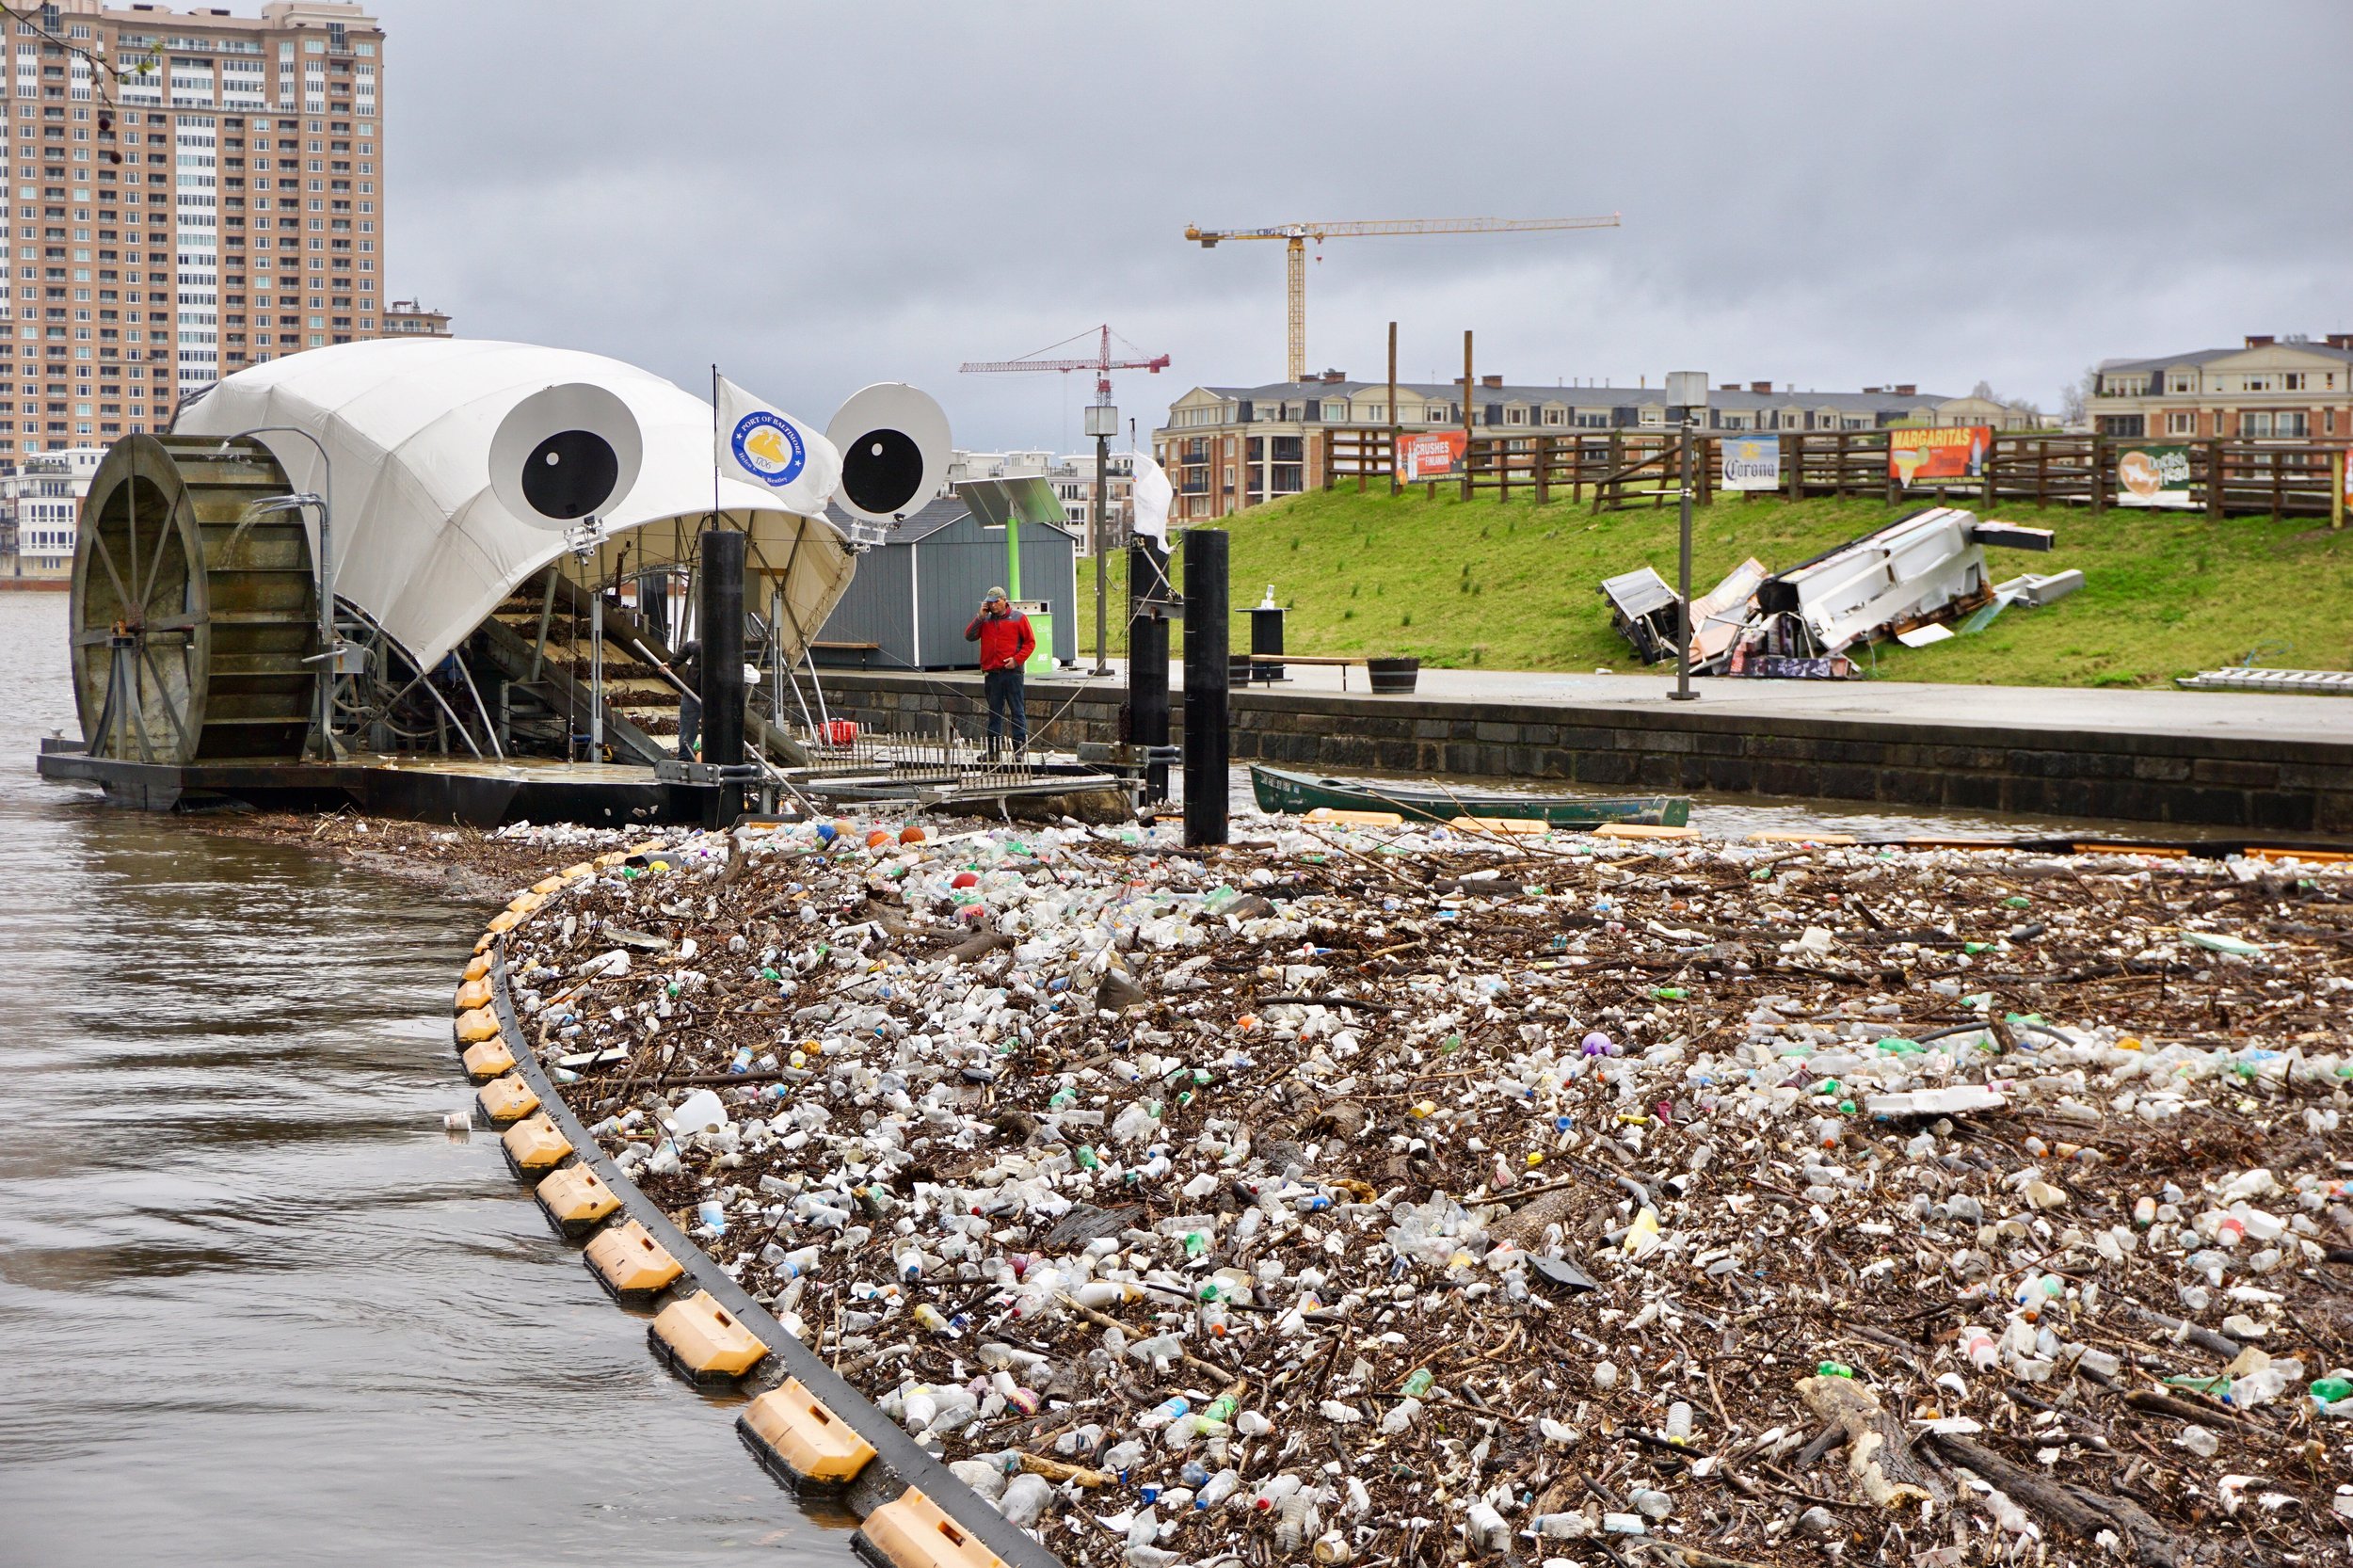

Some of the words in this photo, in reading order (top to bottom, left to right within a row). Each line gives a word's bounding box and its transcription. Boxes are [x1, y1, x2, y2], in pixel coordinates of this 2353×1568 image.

[741, 417, 760, 432] PORT
[773, 418, 802, 456] BALTIMORE
[1892, 428, 1971, 448] MARGARITAS
[1415, 441, 1449, 456] CRUSHES
[755, 456, 772, 470] 1706
[1724, 458, 1775, 483] Corona
[2159, 463, 2190, 486] Head
